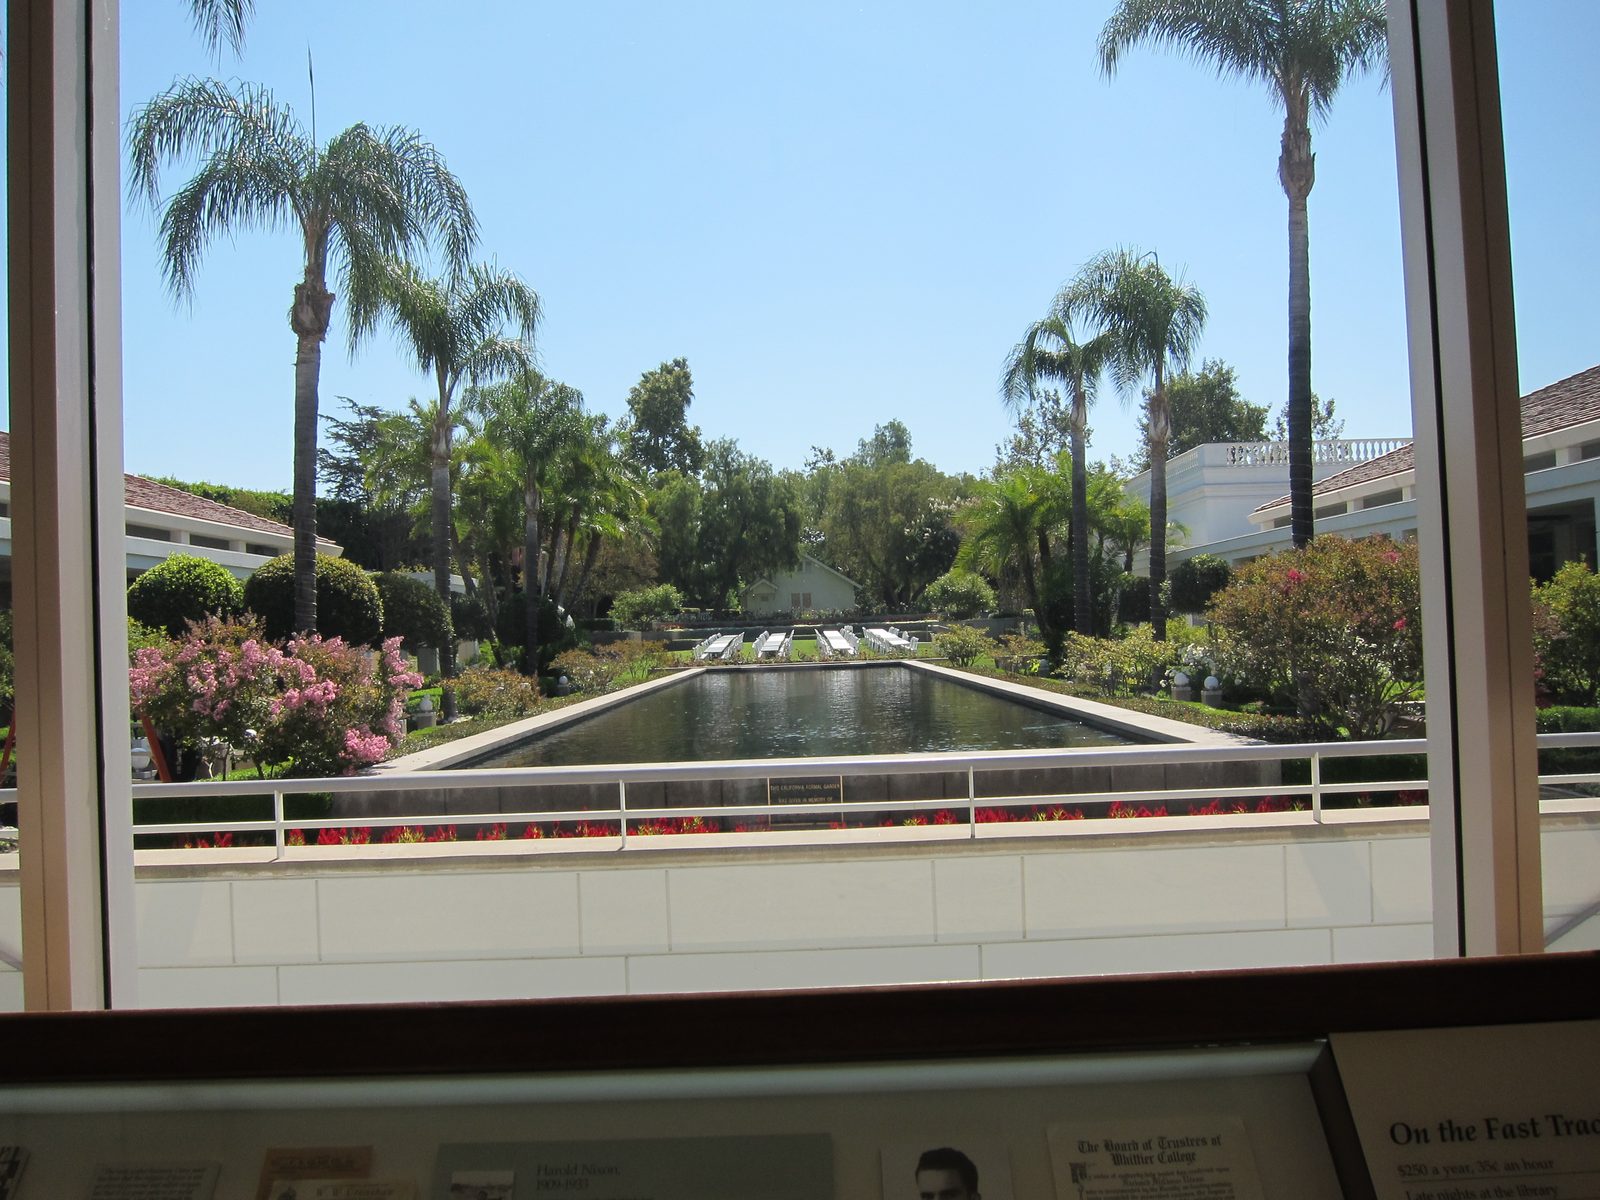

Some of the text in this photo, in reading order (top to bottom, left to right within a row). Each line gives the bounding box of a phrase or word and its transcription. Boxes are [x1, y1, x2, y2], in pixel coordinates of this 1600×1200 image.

[1389, 1114, 1600, 1146] On the Fast Trac
[1078, 1140, 1099, 1153] The
[1142, 1138, 1153, 1152] of
[1157, 1135, 1208, 1150] Trustees
[1211, 1134, 1222, 1147] of
[536, 1163, 578, 1177] Harold
[1397, 1163, 1428, 1177] $250
[1432, 1166, 1440, 1175] a
[1504, 1161, 1520, 1171] an
[1520, 1157, 1554, 1170] hour
[1480, 1188, 1492, 1200] at
[1493, 1184, 1514, 1198] the
[1516, 1184, 1559, 1200] library
